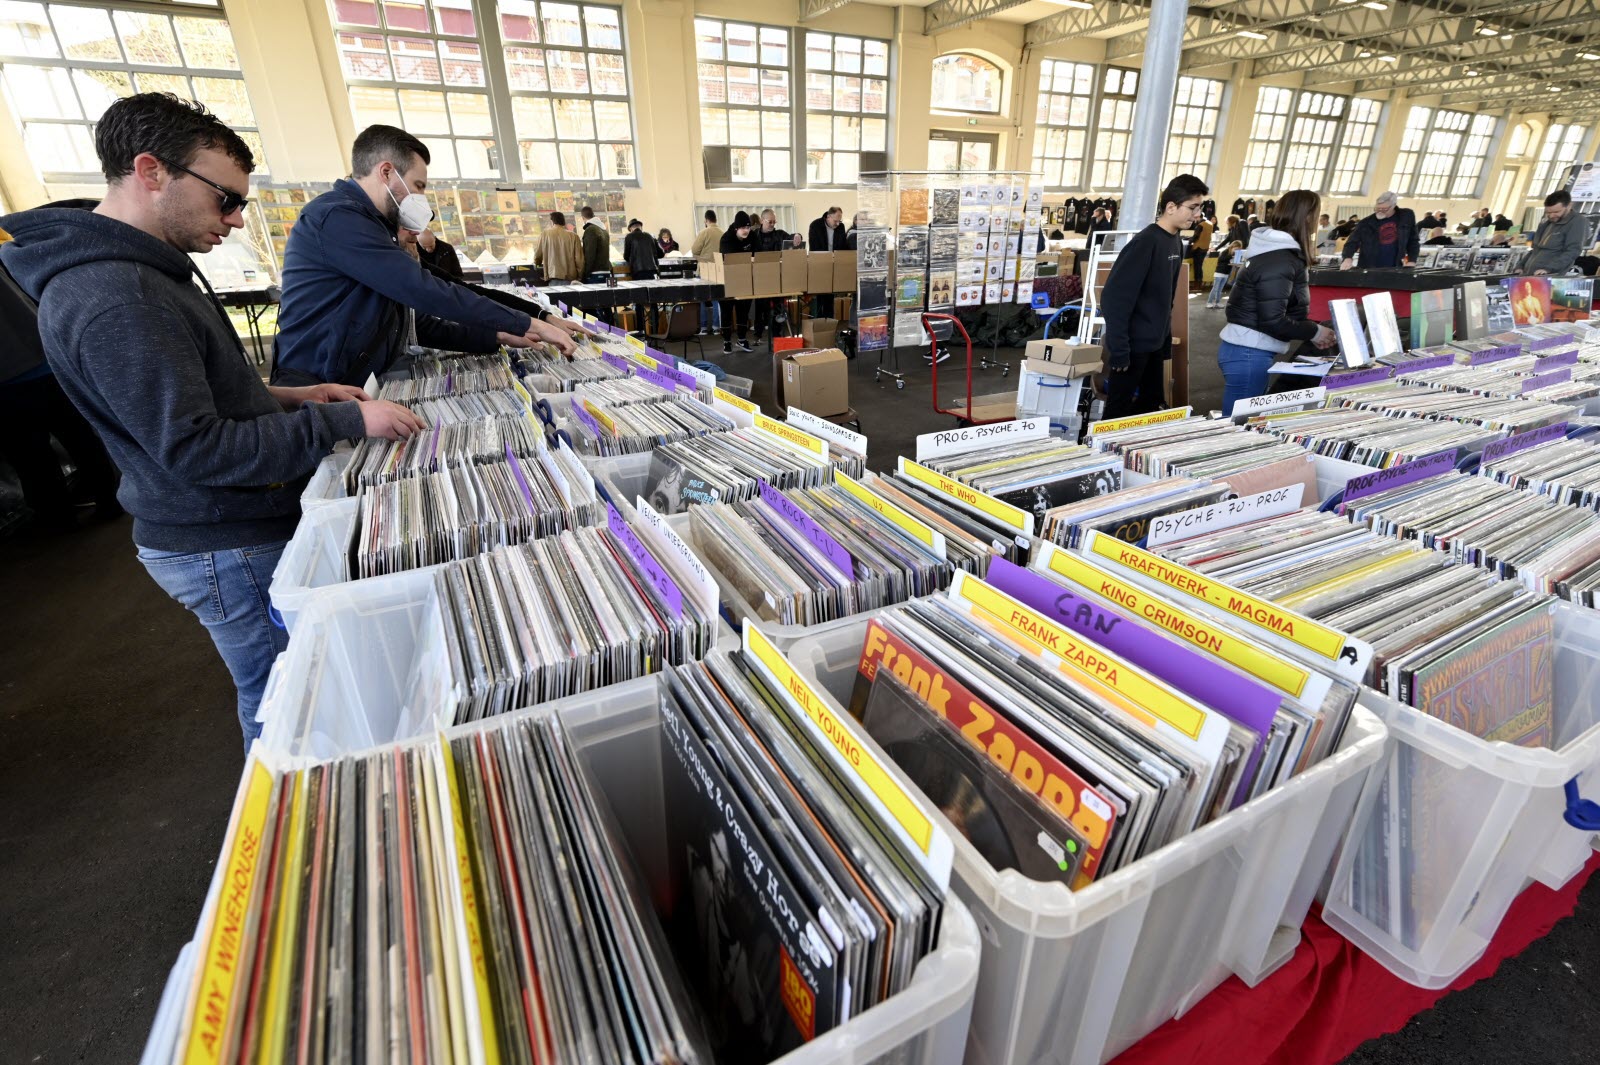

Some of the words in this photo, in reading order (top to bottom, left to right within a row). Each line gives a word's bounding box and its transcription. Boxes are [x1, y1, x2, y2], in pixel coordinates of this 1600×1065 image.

[664, 366, 682, 382] PRINCE
[1304, 389, 1315, 399] 70
[762, 420, 777, 433] BRUCE
[777, 425, 811, 448] SPRINGSTEEN
[1021, 420, 1036, 431] 70
[761, 482, 778, 504] POP
[781, 499, 807, 530] ROCK
[872, 498, 884, 513] U2
[939, 479, 954, 494] THE
[956, 488, 977, 504] WHO
[1154, 508, 1214, 539] PSYCHE
[1228, 501, 1245, 515] 70
[1256, 488, 1289, 508] PROG
[640, 502, 661, 528] VELVET
[663, 526, 706, 583] UNDERGROUND
[660, 577, 668, 597] S
[1119, 549, 1209, 599] KRAFTWERK
[1227, 597, 1295, 638] MAGMA
[1053, 593, 1122, 635] CAN
[1099, 580, 1138, 609] KING
[1143, 603, 1224, 653] CRIMSON
[1010, 610, 1060, 649] FRANK
[1064, 642, 1118, 686] ZAPPA
[789, 675, 813, 714] NEIL
[816, 699, 862, 768] YOUNG
[660, 693, 681, 739] Neil
[682, 728, 714, 800] Young
[724, 802, 765, 875] Crazy
[201, 978, 226, 1060] AMY
[214, 826, 259, 974] WINEHOUSE
